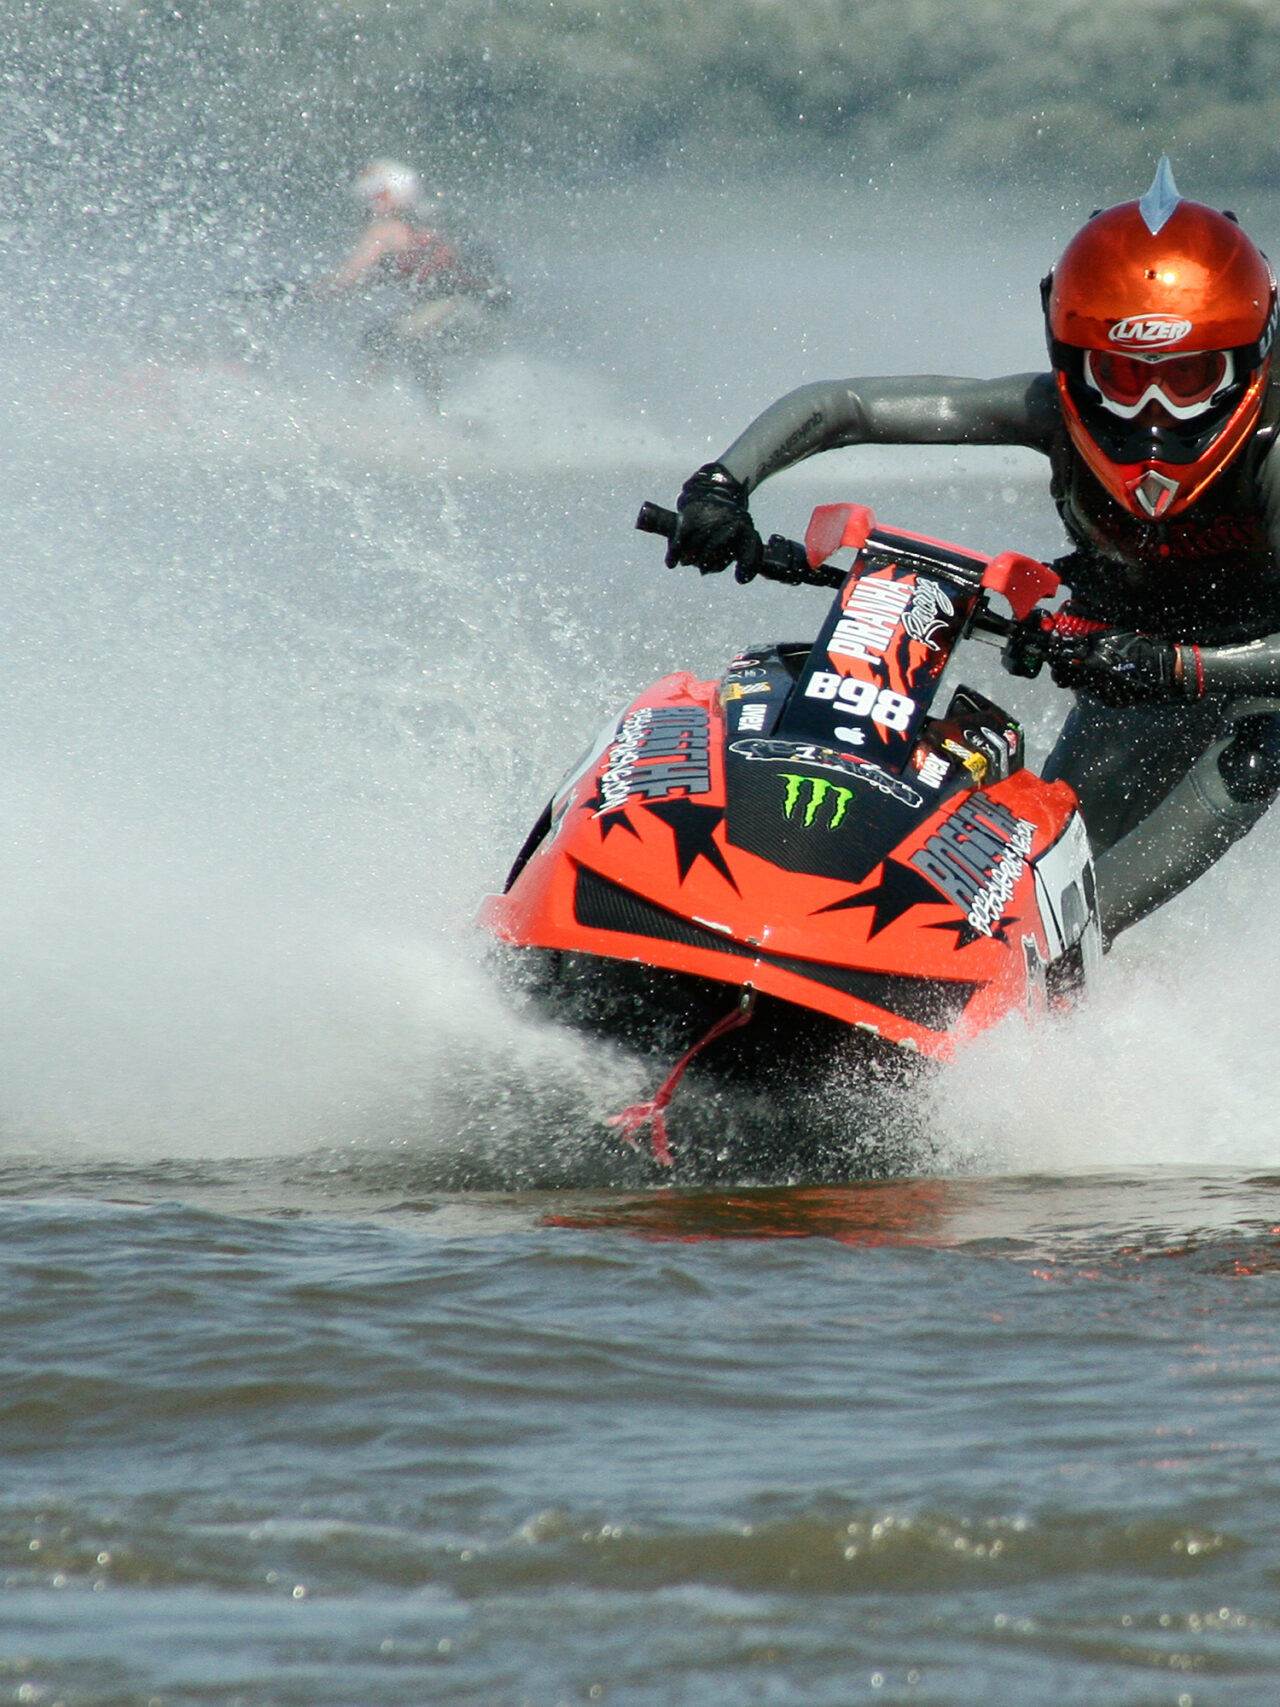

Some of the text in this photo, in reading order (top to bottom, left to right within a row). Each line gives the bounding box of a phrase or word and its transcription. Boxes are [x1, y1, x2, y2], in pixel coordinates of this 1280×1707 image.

[1116, 320, 1188, 342] LAZER
[826, 575, 915, 666] PIRANHA
[901, 575, 956, 652] Racing
[737, 703, 768, 732] uvex
[804, 671, 916, 733] B98
[916, 752, 951, 790] uvex
[909, 791, 1023, 915] BOSSCHE
